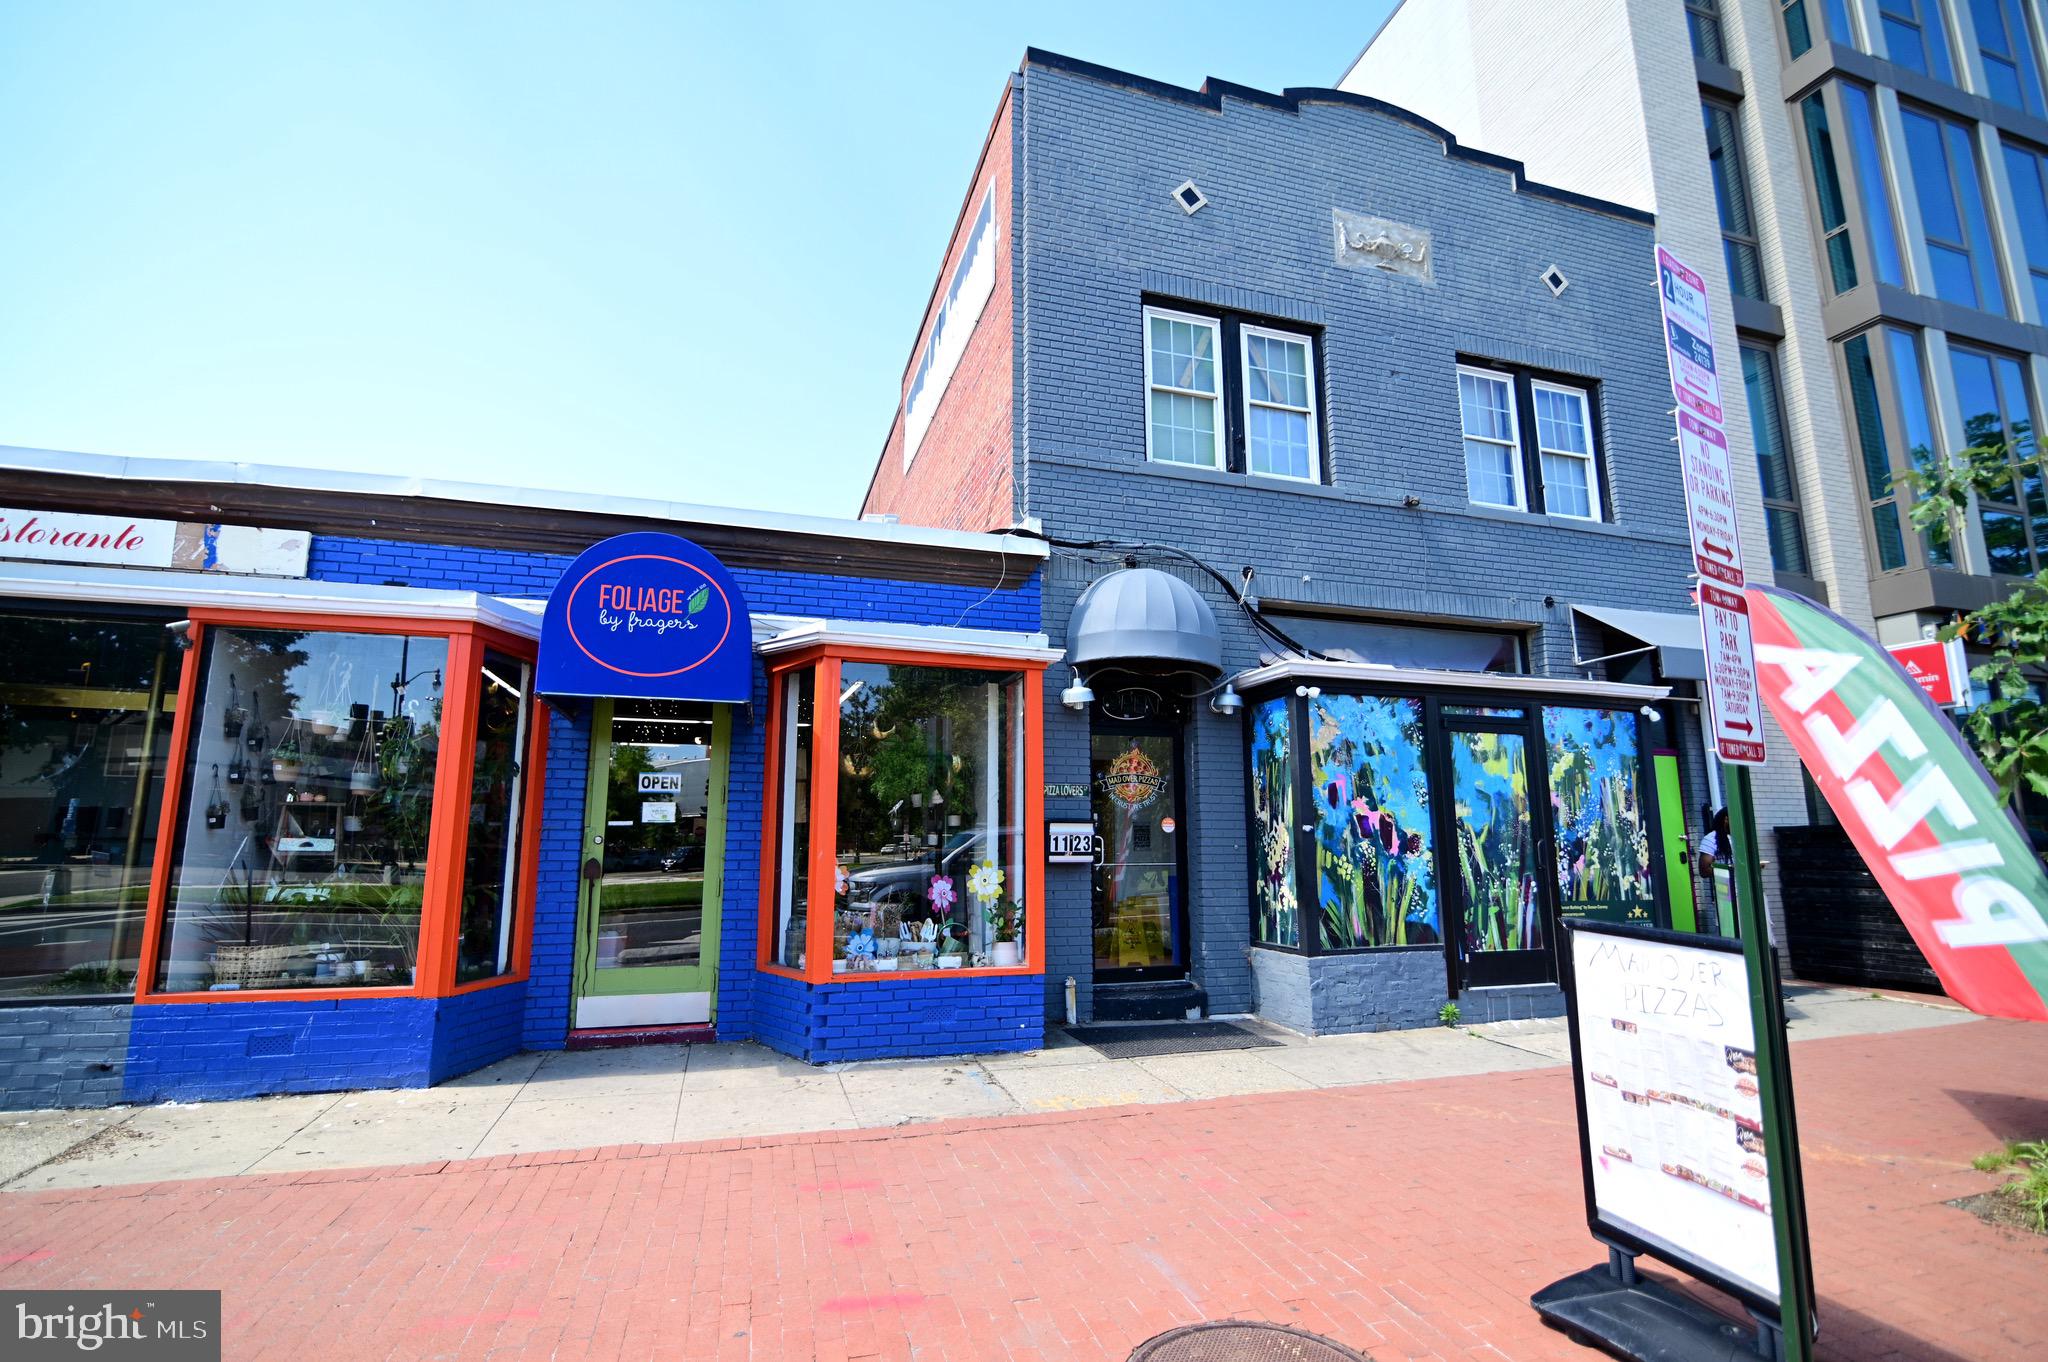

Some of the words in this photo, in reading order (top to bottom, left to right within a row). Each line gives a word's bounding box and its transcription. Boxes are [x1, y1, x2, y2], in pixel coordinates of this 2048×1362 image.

[1664, 269, 1673, 299] 2
[1674, 282, 1694, 304] HOUR
[1700, 441, 1710, 460] NO
[1690, 454, 1725, 486] STANDING
[1689, 473, 1699, 494] OR
[1701, 479, 1731, 508] PARKING
[599, 584, 684, 613] FOLIAGE
[600, 609, 622, 631] by
[628, 611, 698, 634] fragers
[1714, 608, 1727, 629] PAY
[1729, 612, 1739, 632] TO
[1720, 632, 1739, 653] PARK
[1725, 701, 1749, 715] SATURDAY
[641, 776, 679, 789] OPEN
[1061, 785, 1084, 796] LOVERS
[1108, 776, 1121, 784] MAD
[1139, 775, 1158, 785] PIZZAS
[1623, 982, 1724, 1027] PIZZAS
